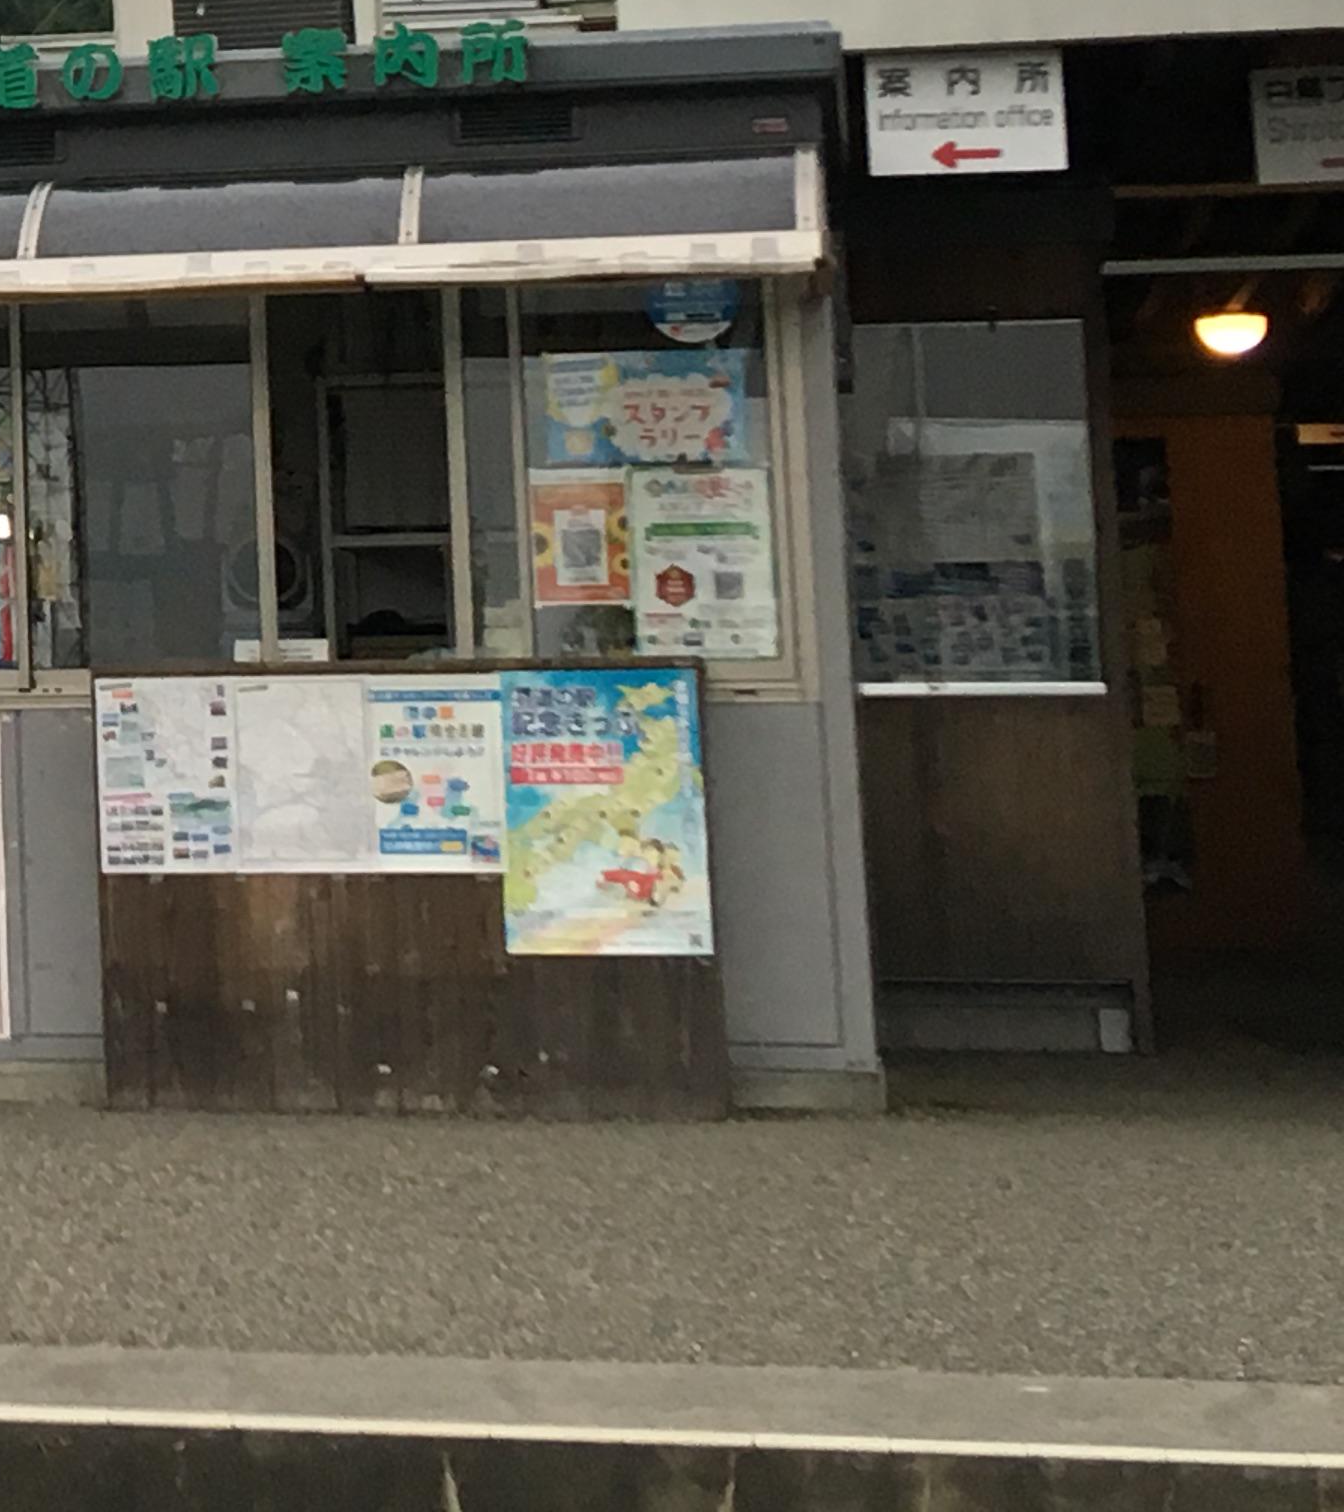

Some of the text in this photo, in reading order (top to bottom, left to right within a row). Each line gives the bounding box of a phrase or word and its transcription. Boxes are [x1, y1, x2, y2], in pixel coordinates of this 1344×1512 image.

[282, 20, 528, 93] 案内所
[876, 59, 1052, 99] 案内所
[877, 104, 1054, 132] Information office
